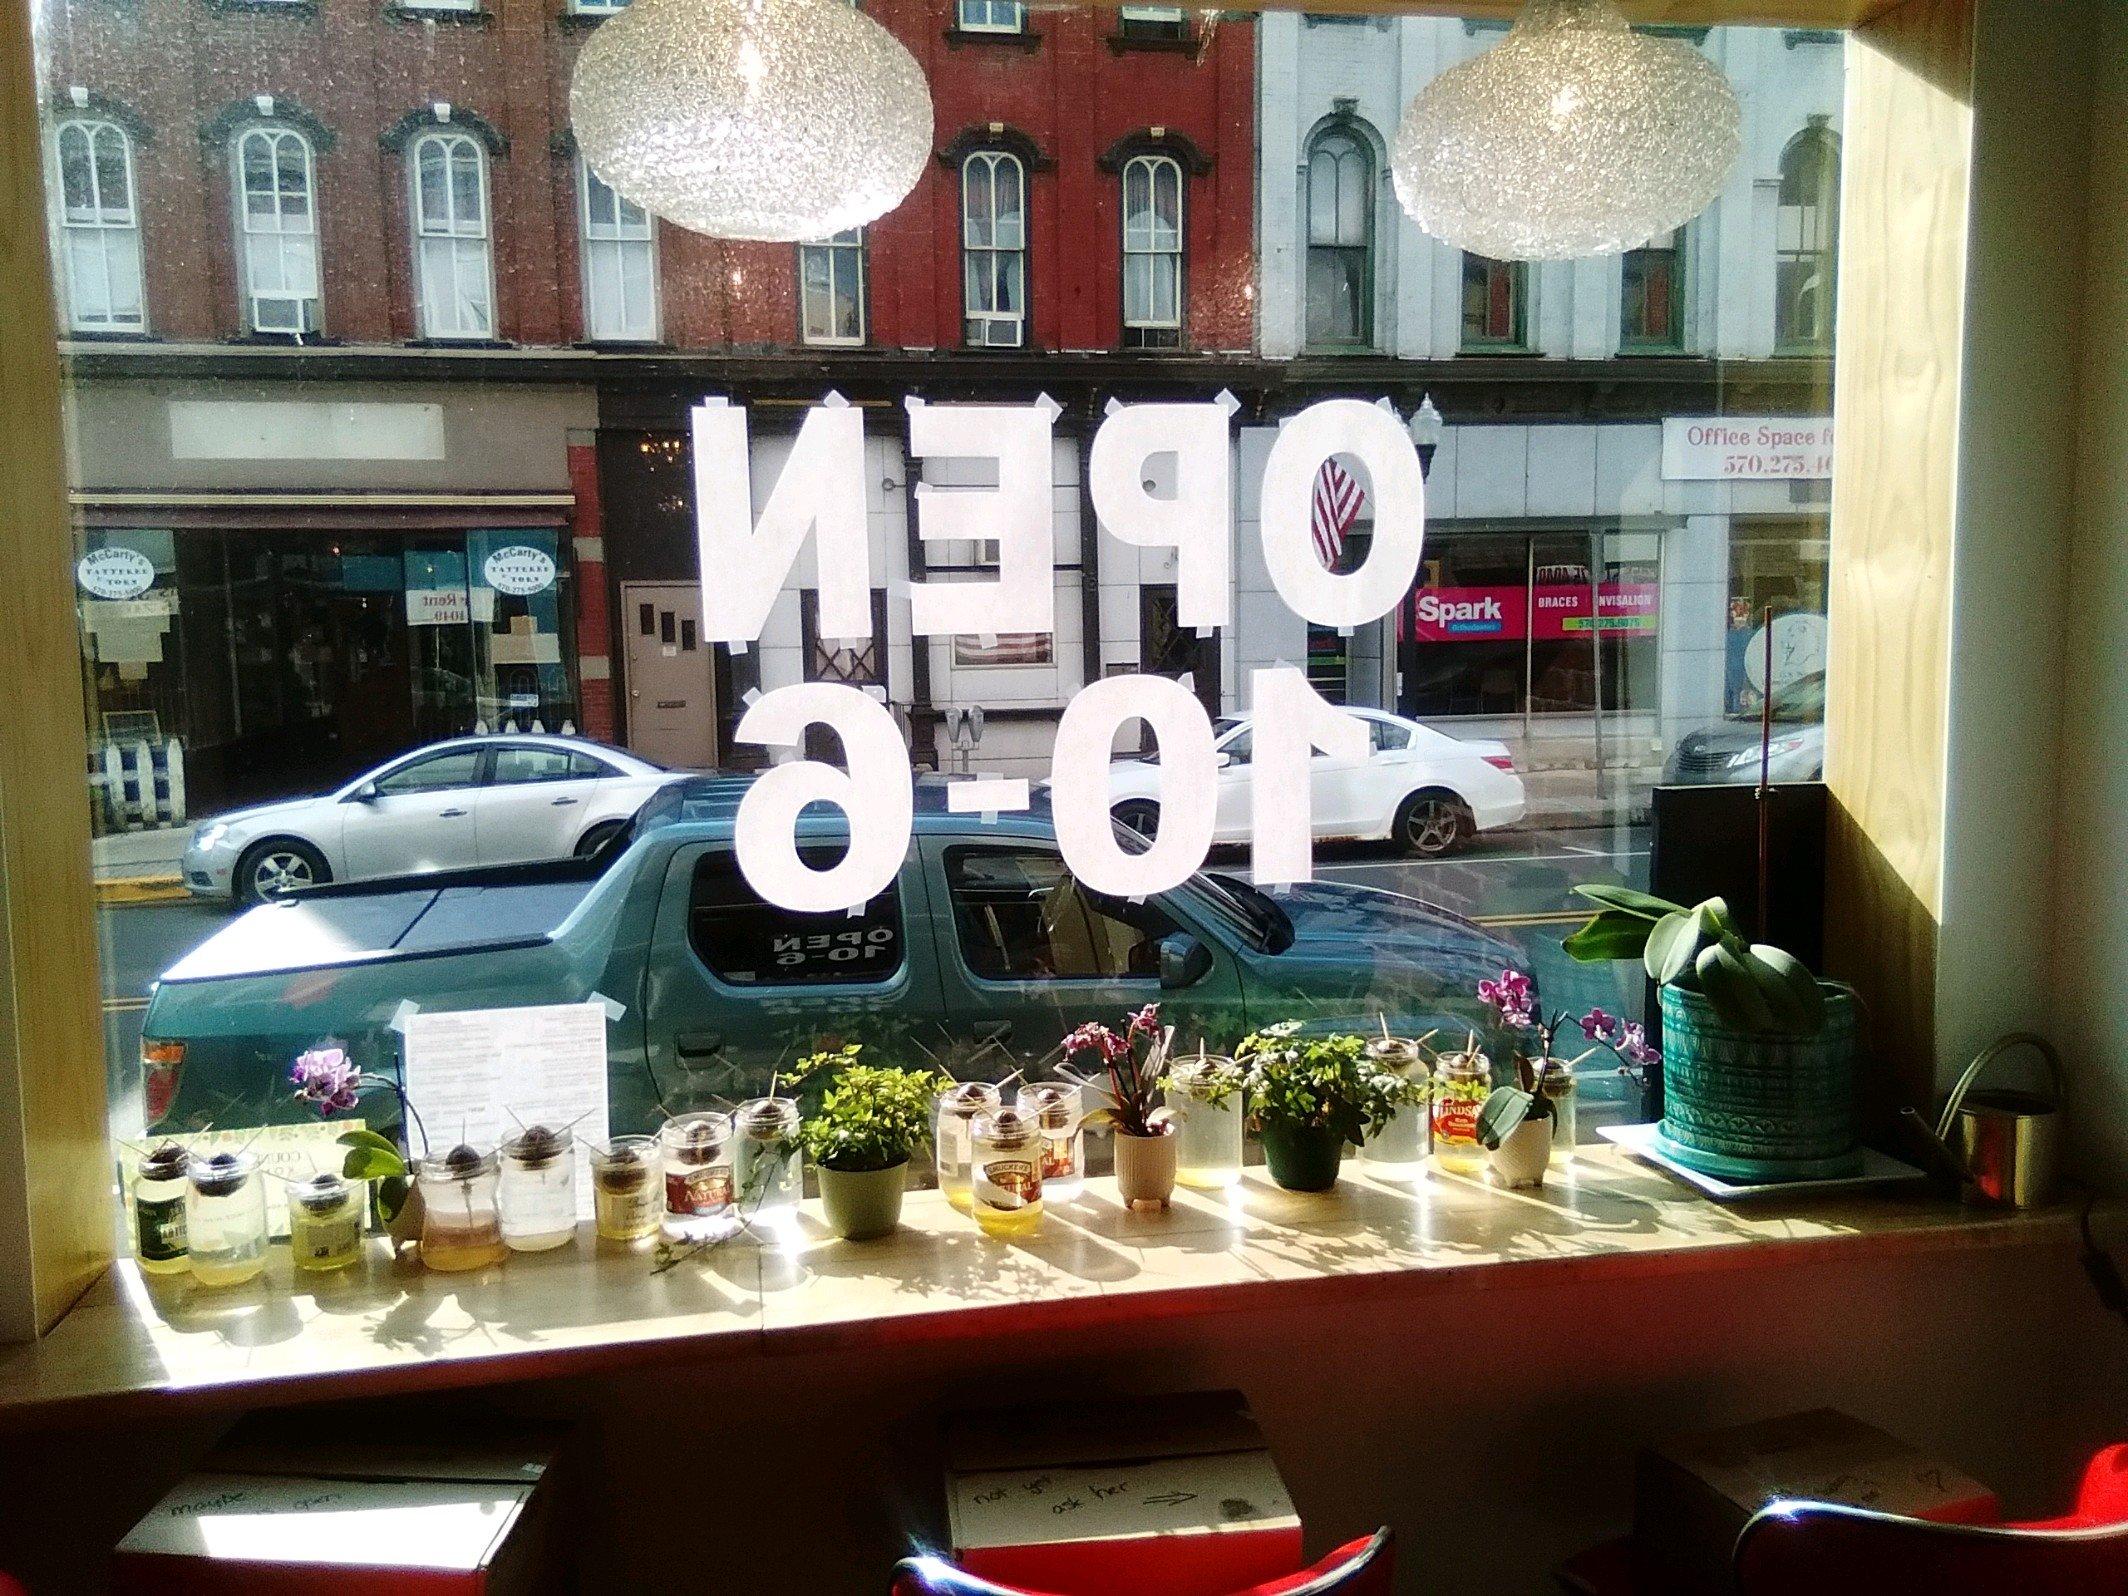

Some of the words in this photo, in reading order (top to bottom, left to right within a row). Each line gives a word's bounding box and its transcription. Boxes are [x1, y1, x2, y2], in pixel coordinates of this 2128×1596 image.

[1687, 425, 1750, 446] Office
[1757, 425, 1815, 449] Space
[87, 548, 145, 566] McCarty's
[492, 547, 546, 564] McCarty's
[1538, 596, 1578, 609] BRACES
[1595, 594, 1651, 607] NVISALIGN
[1418, 595, 1502, 628] Spark
[1438, 1105, 1480, 1118] LINDSA
[1088, 1480, 1129, 1501] her
